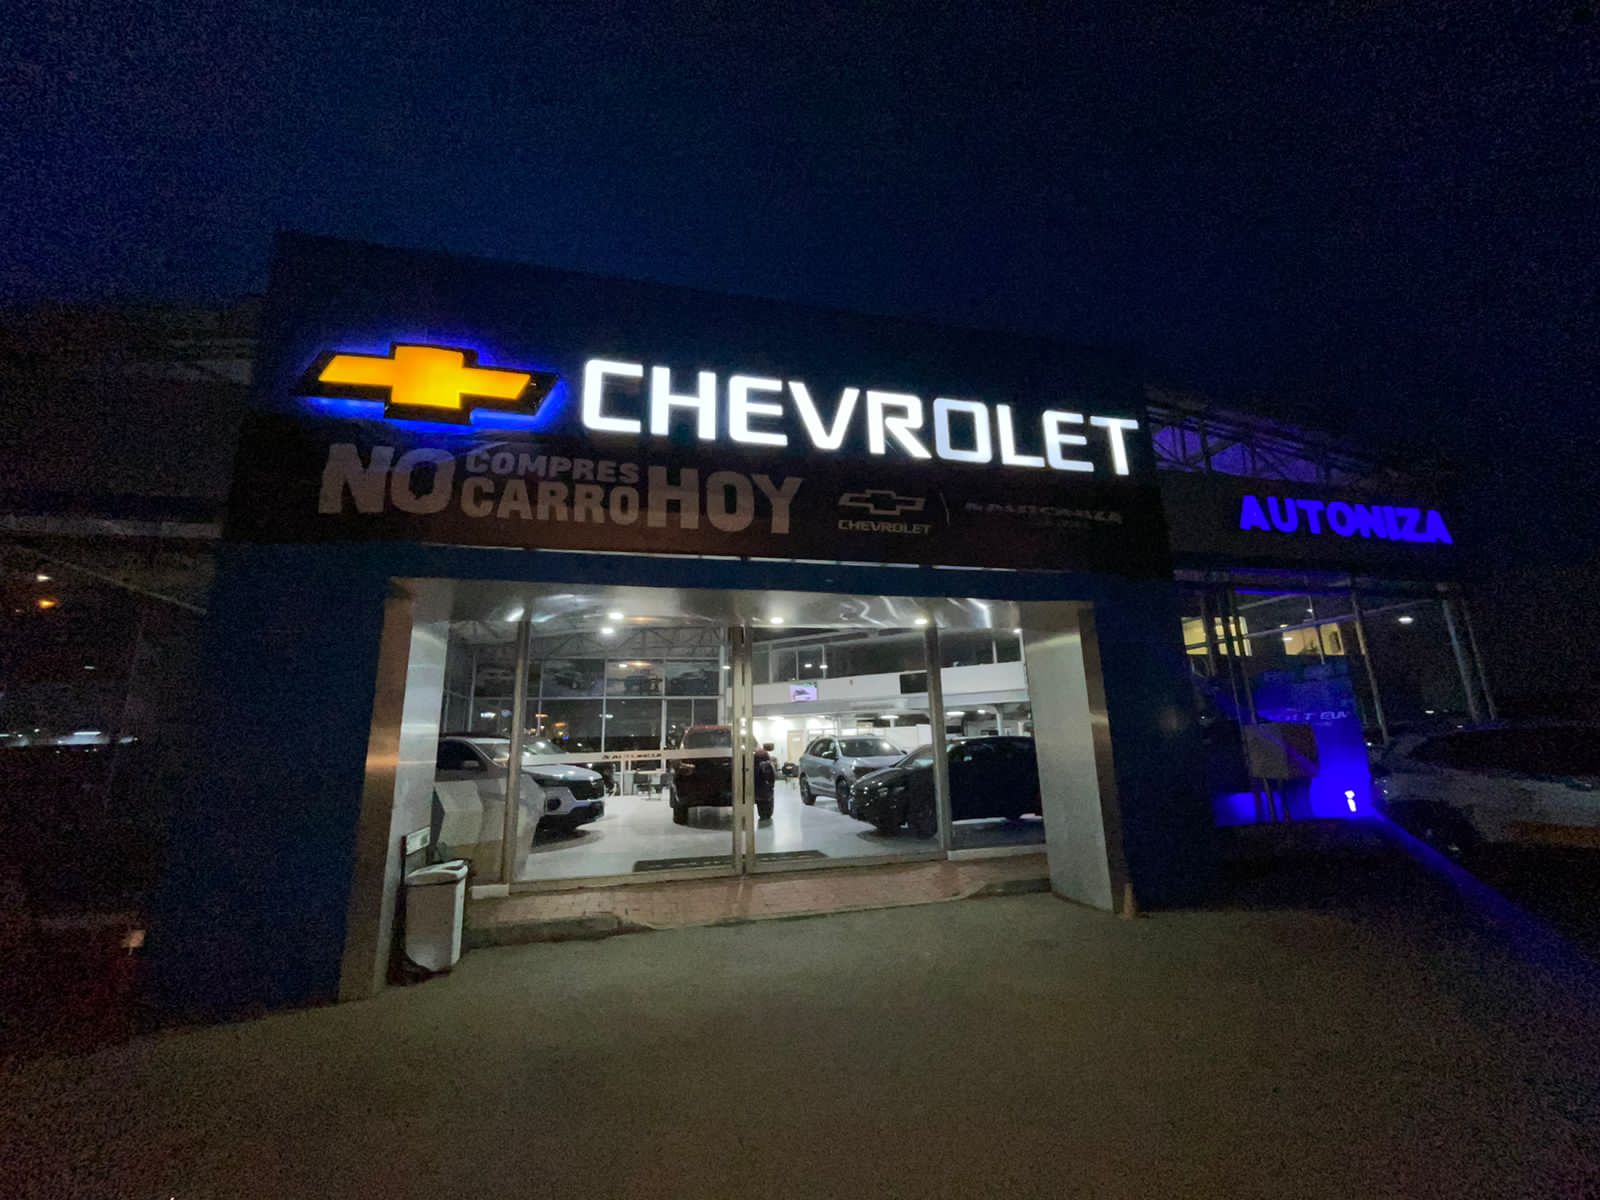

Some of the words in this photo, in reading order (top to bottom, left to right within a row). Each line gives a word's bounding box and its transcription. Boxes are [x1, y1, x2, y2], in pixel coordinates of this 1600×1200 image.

[581, 358, 1140, 477] CHEVROLET
[316, 442, 457, 517] NO
[464, 450, 641, 486] COMPRES
[459, 475, 640, 527] CARRO
[646, 464, 806, 536] HOY
[1239, 495, 1453, 545] AUTONIZA
[837, 519, 933, 535] CHEVROLET
